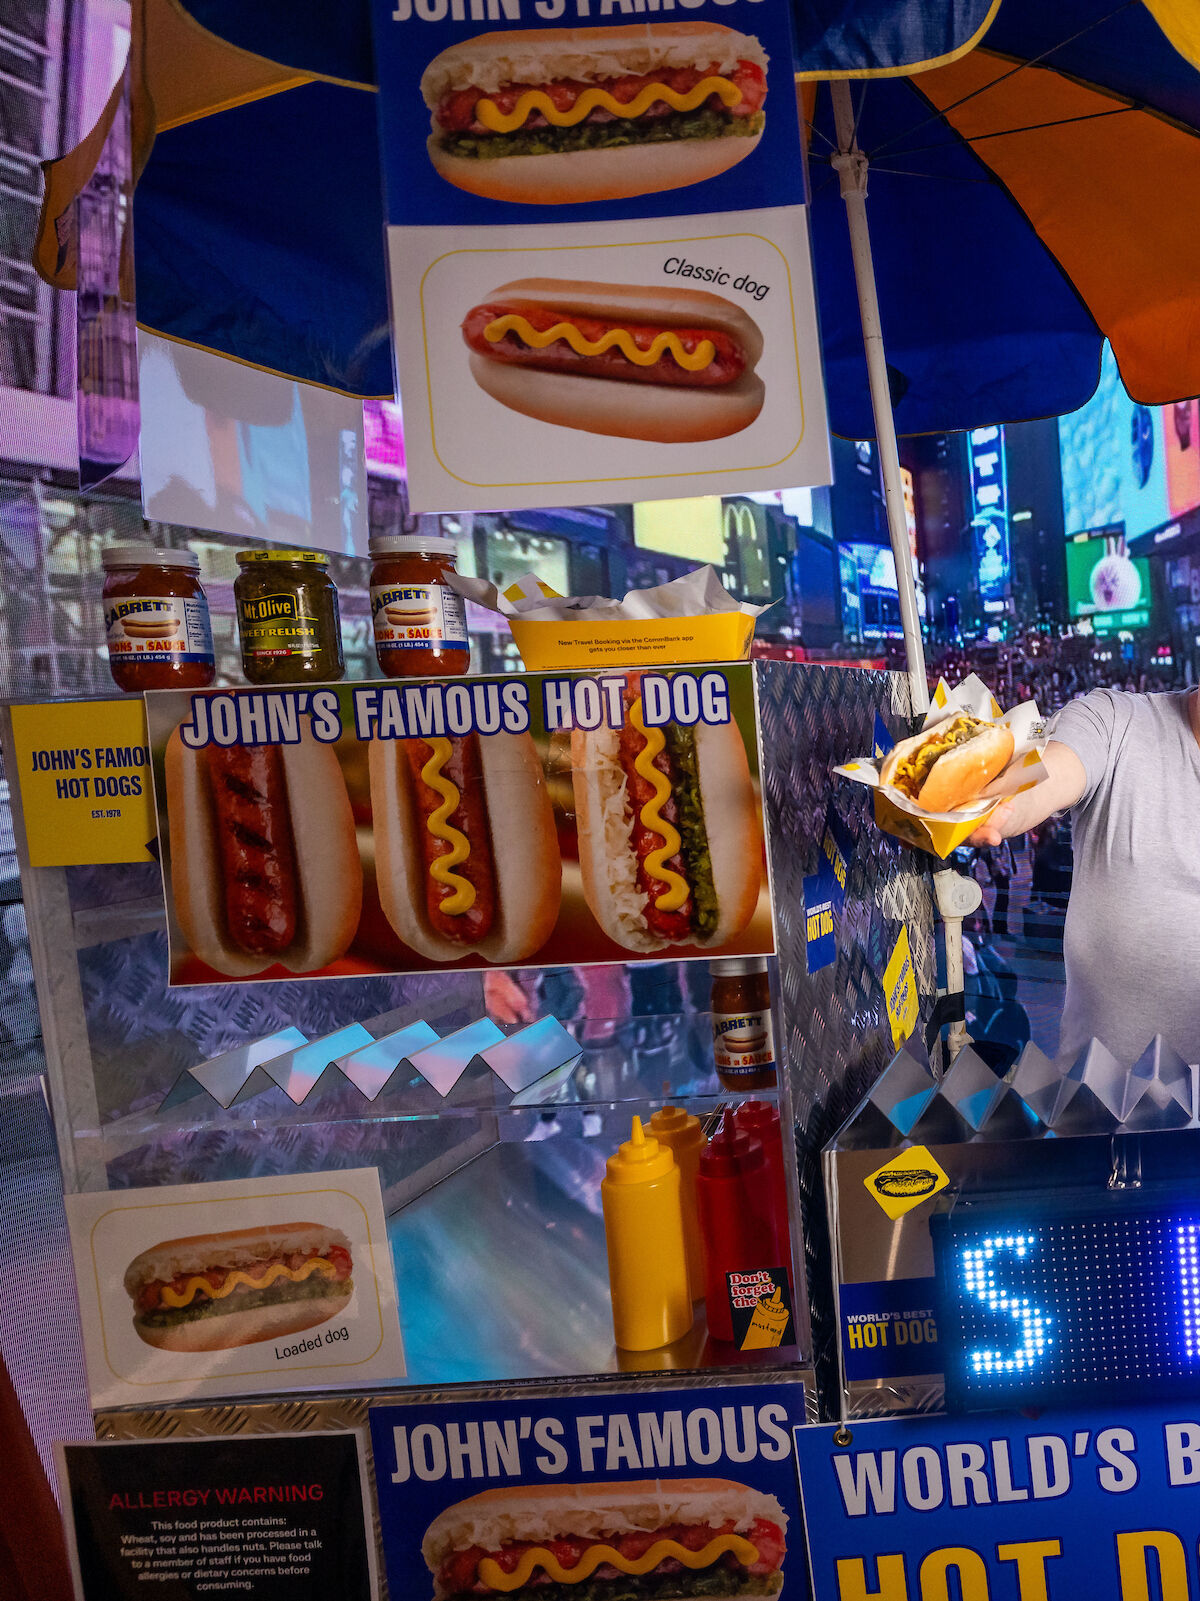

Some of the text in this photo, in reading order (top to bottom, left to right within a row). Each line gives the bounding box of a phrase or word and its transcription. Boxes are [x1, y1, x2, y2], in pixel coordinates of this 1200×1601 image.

[663, 257, 770, 300] Classic dog
[244, 600, 292, 619] Mt. Olive
[374, 586, 431, 614] ABRETT
[243, 628, 314, 637] WEET RELISH
[594, 638, 620, 646] Booking
[183, 674, 728, 747] JOHN'S FAMOUS HOT DOG
[32, 746, 151, 771] JOHN'S FAMO
[56, 775, 142, 799] HOT DOGS
[806, 910, 834, 942] HOT DOG
[715, 1016, 762, 1037] ABRETT
[730, 1271, 770, 1285] Don't
[731, 1283, 775, 1297] forget
[733, 1296, 758, 1308] the
[963, 1235, 1053, 1374] S
[847, 1310, 934, 1324] WORLD'S BEST
[275, 1326, 350, 1360] Loaded dog
[848, 1318, 938, 1349] HOT DOG
[392, 1404, 792, 1484] JOHN'S FAMOUS
[834, 1427, 1137, 1517] WORLD'S
[108, 1484, 324, 1510] ALLERGY WARNING
[152, 1517, 287, 1530] This food product contains:
[120, 1534, 157, 1544] Wheat,
[160, 1535, 176, 1544] soy
[178, 1533, 198, 1542] and
[200, 1532, 218, 1541] has
[220, 1532, 244, 1540] been
[246, 1529, 296, 1540] processed
[299, 1528, 308, 1537] in
[120, 1540, 322, 1558] facility that also handles nuts. Please talk
[131, 1560, 142, 1569] to
[152, 1558, 194, 1568] member
[196, 1557, 207, 1566] of
[209, 1556, 232, 1565] staff
[234, 1556, 240, 1564] if
[243, 1556, 261, 1565] you
[263, 1554, 286, 1563] have
[288, 1553, 312, 1562] food
[138, 1572, 179, 1582] allergies
[194, 1569, 229, 1580] dietary
[230, 1568, 276, 1577] concerns
[278, 1566, 310, 1575] before
[196, 1580, 254, 1591] consuming.
